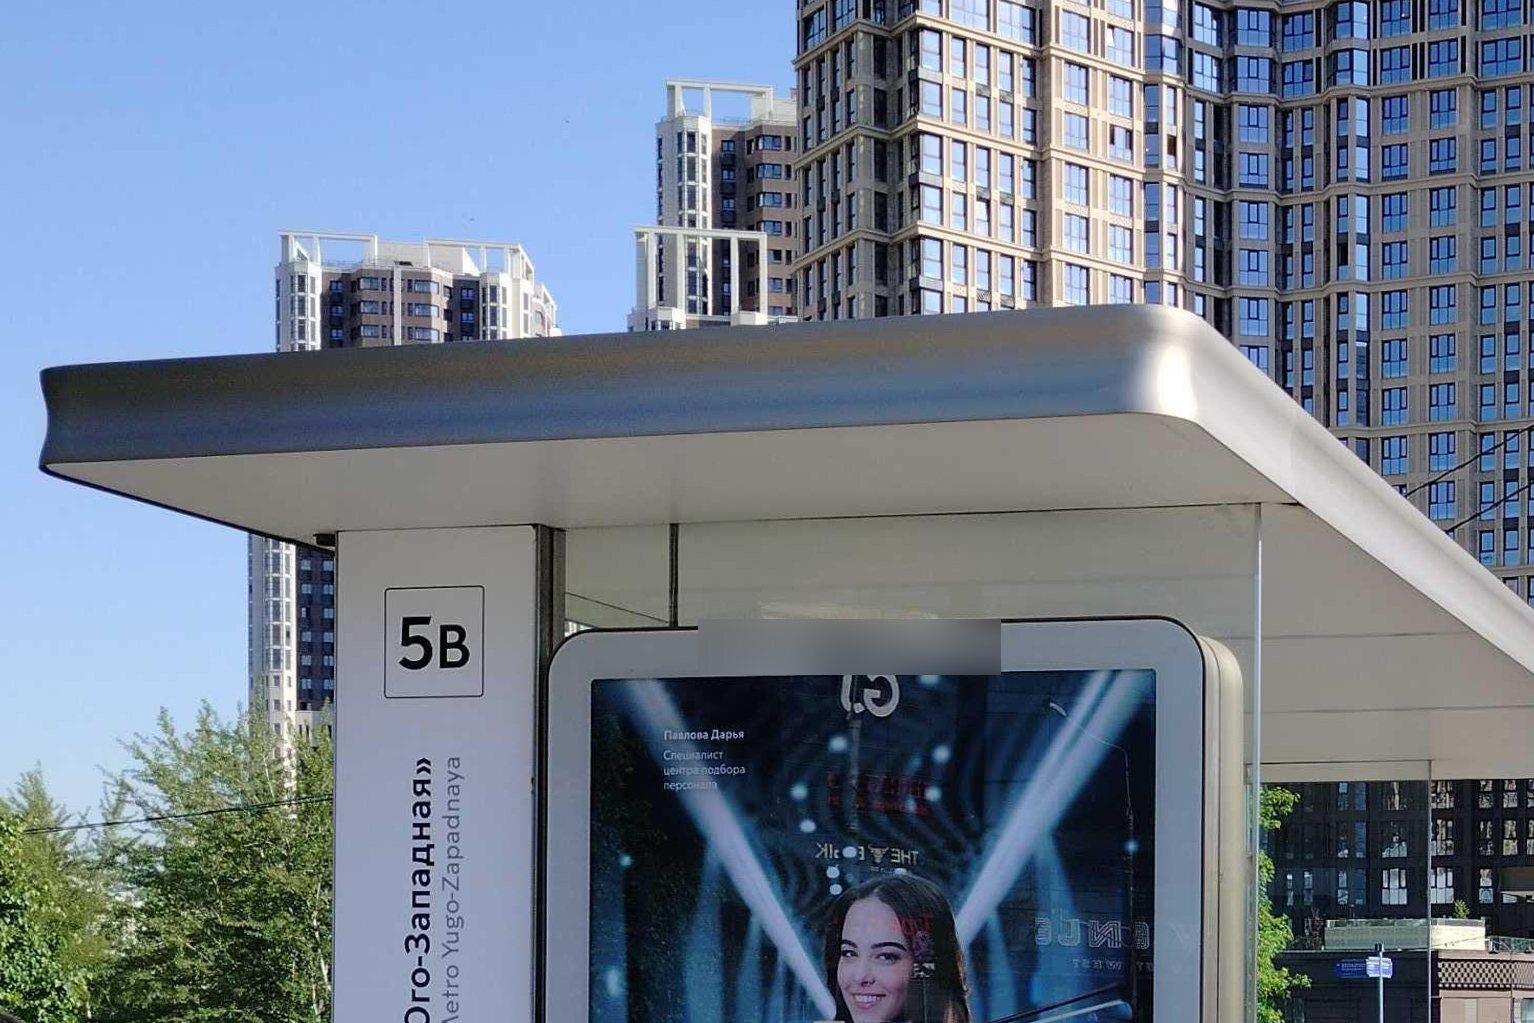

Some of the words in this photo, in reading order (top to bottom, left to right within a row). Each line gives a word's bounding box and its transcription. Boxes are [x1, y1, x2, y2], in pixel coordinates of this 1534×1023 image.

[398, 615, 471, 670] 5В
[711, 729, 744, 741] Дарья
[442, 755, 465, 961] Yugo-Zapadnaya
